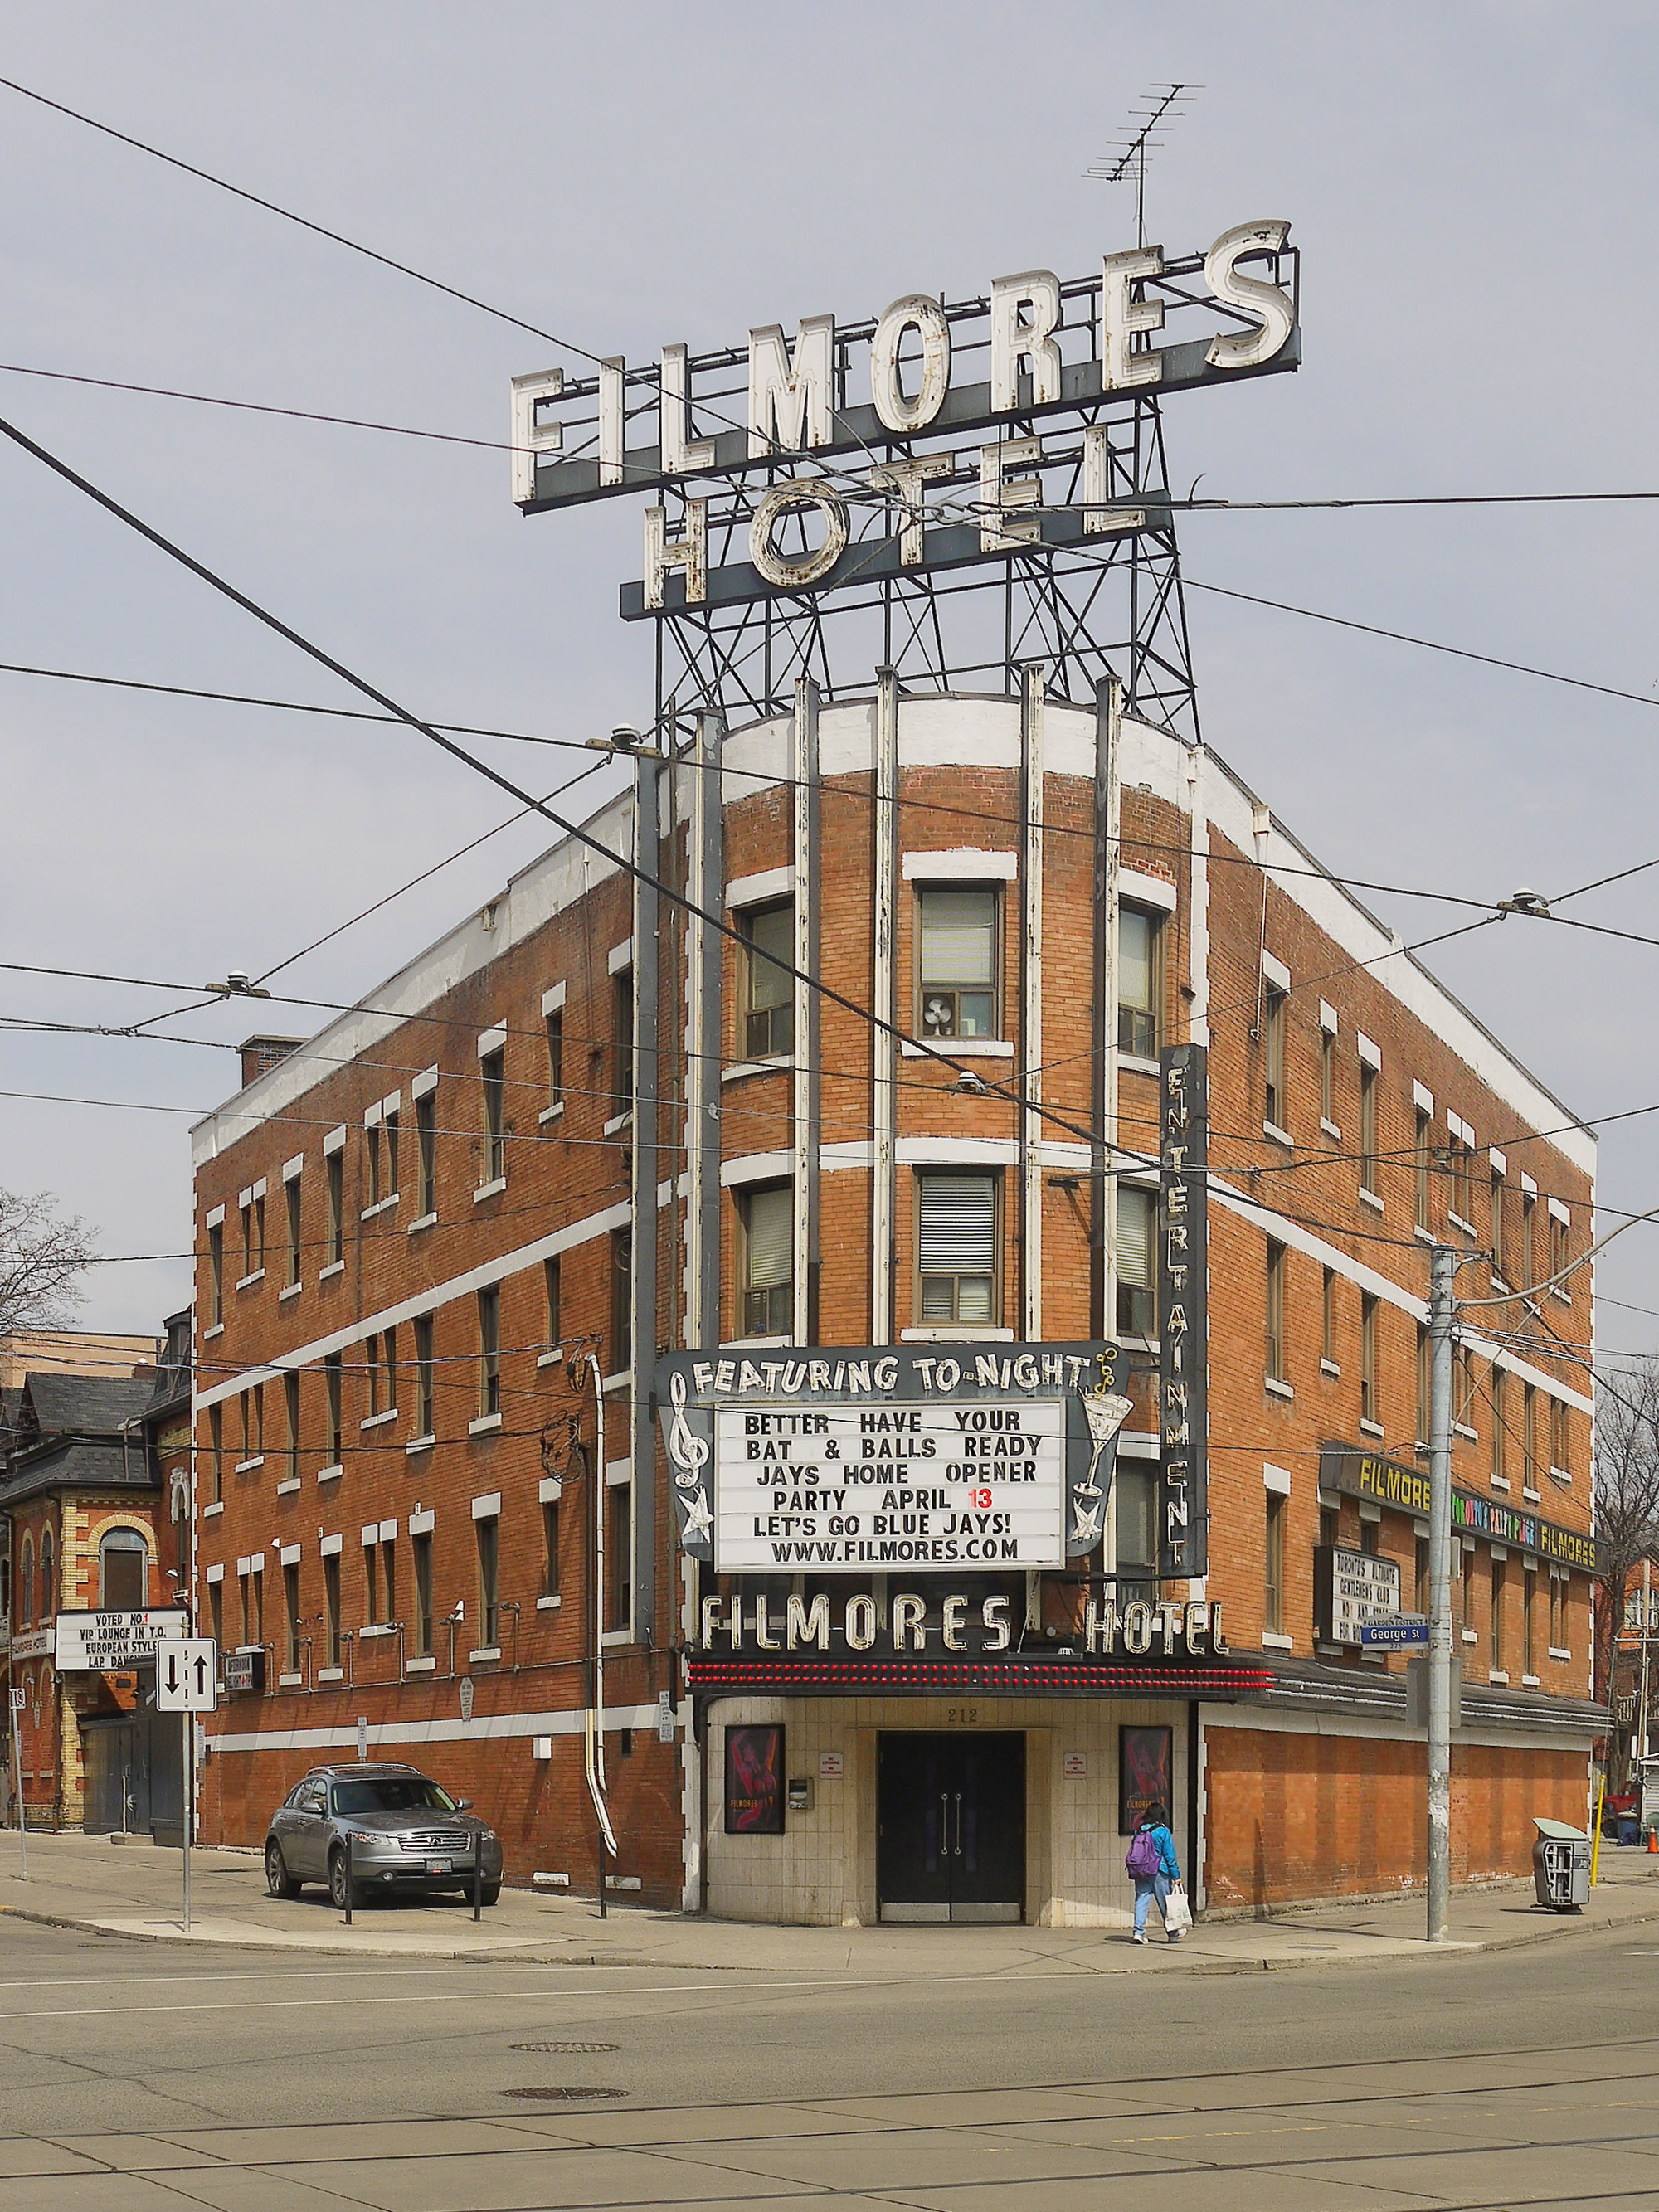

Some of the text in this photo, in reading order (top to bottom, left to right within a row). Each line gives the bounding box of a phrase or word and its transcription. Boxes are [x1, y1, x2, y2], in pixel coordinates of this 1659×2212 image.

[511, 218, 1295, 503] FILMORES
[644, 425, 1147, 611] HOTEL
[1167, 1067, 1190, 1568] ENTERTAINMENT
[693, 1354, 1091, 1394] FEATURING TO-NIGHT
[745, 1411, 1020, 1436] BETTER HAVE YOUR
[747, 1435, 1042, 1461] BAT & BALLS READY
[757, 1461, 1037, 1486] JAYS HOME OPENER
[1360, 1459, 1431, 1511] FILMORE
[773, 1488, 993, 1511] PARTY APRIL 13
[754, 1513, 1011, 1537] LET'S GO BLUE JAYS!
[771, 1539, 1019, 1563] WWW.FILMORES.COM
[1541, 1526, 1596, 1568] FILMORES
[95, 1614, 123, 1626] VOTED
[702, 1593, 1230, 1656] FILMORES HOTEL
[80, 1626, 166, 1641] VIP LOUNGE IN T.O.
[1370, 1628, 1407, 1641] George
[1411, 1629, 1420, 1638] St
[86, 1641, 157, 1654] EUROPEAN STYLE
[89, 1656, 105, 1668] LAP
[948, 1709, 977, 1722] 212
